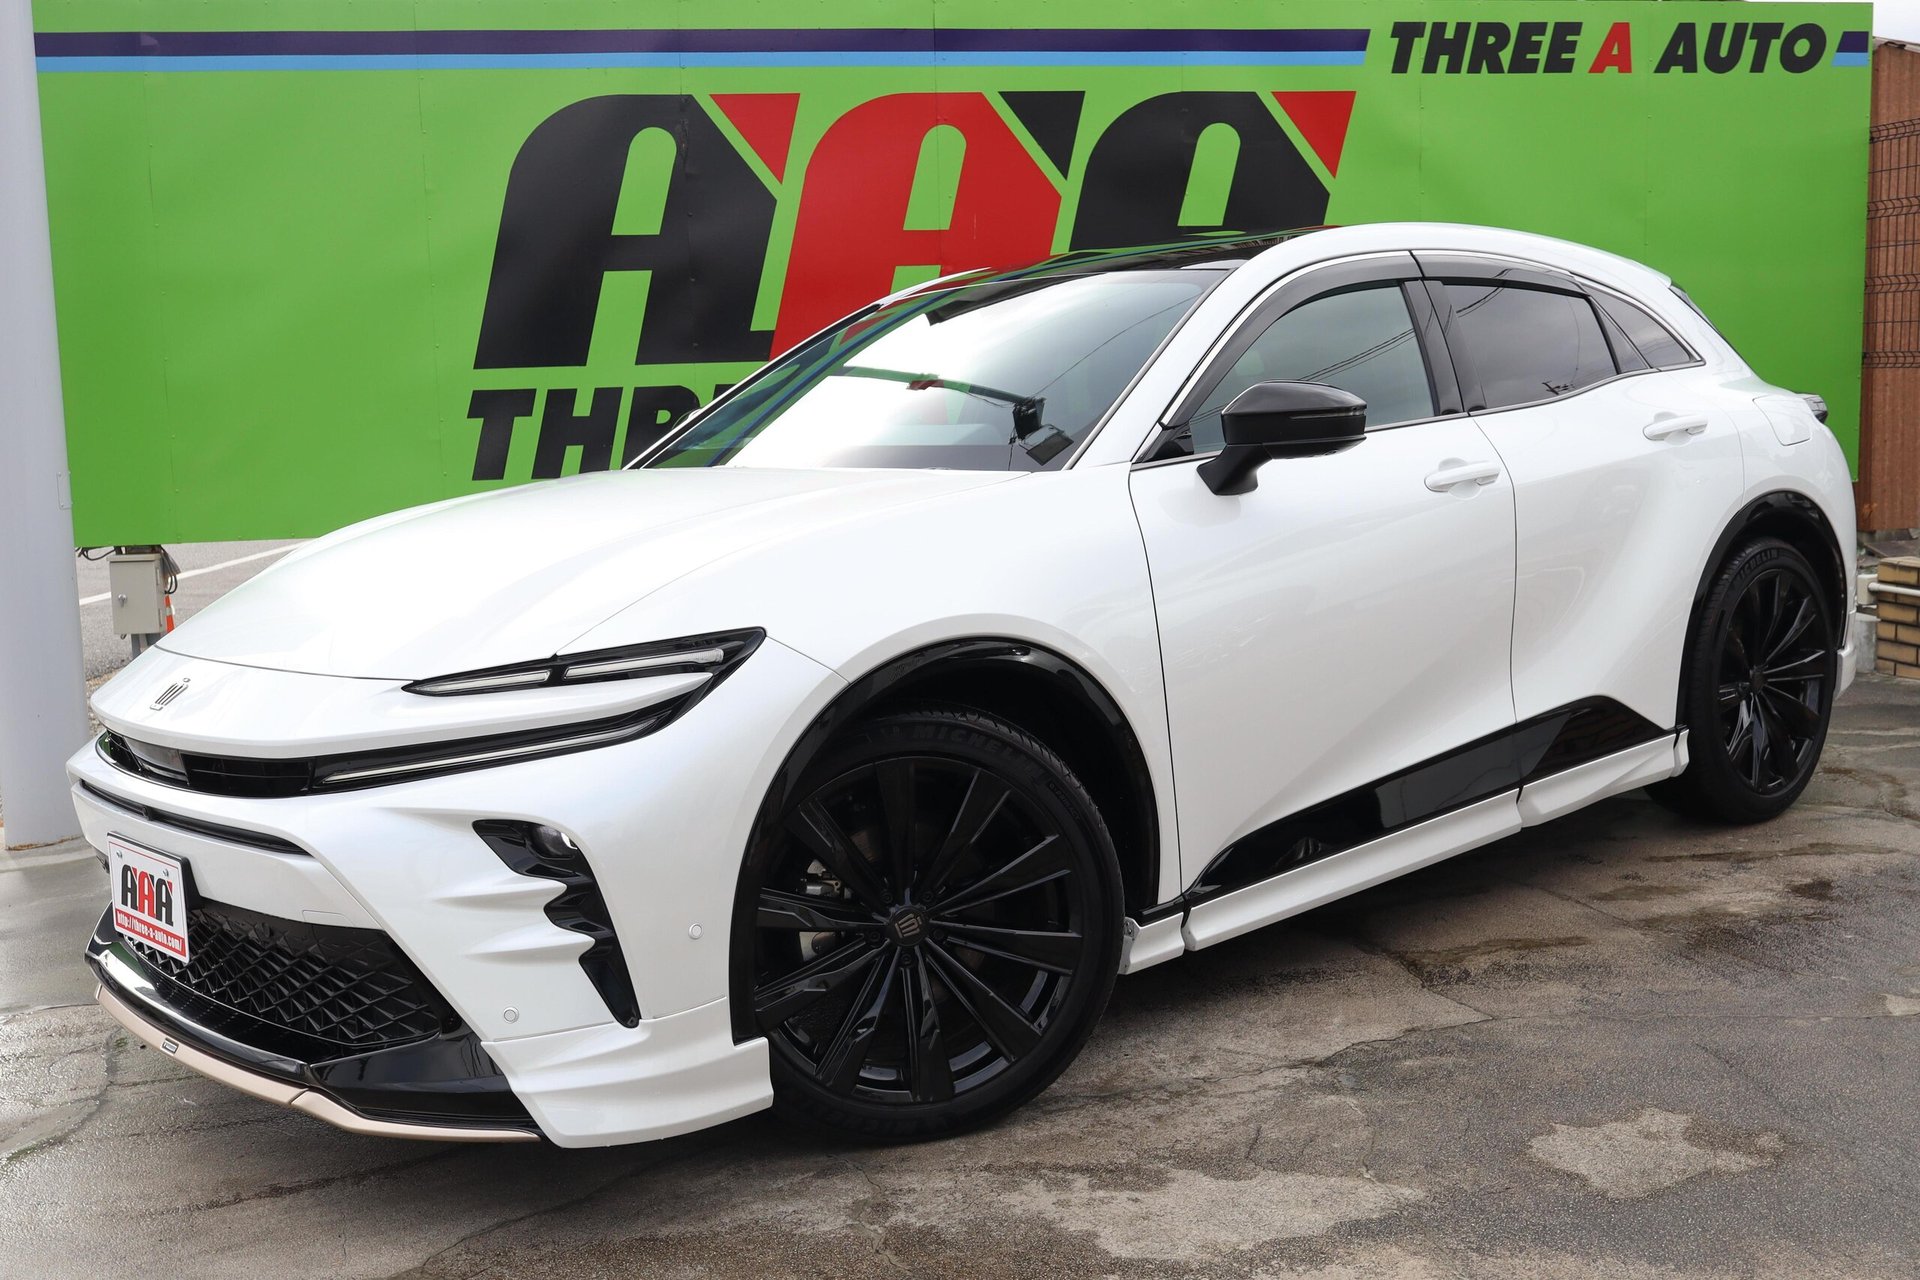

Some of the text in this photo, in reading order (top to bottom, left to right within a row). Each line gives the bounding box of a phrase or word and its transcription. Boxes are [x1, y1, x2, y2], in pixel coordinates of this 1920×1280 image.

[1390, 21, 1827, 74] THREE A AUTO
[467, 384, 739, 480] THR
[121, 864, 174, 927] AAA
